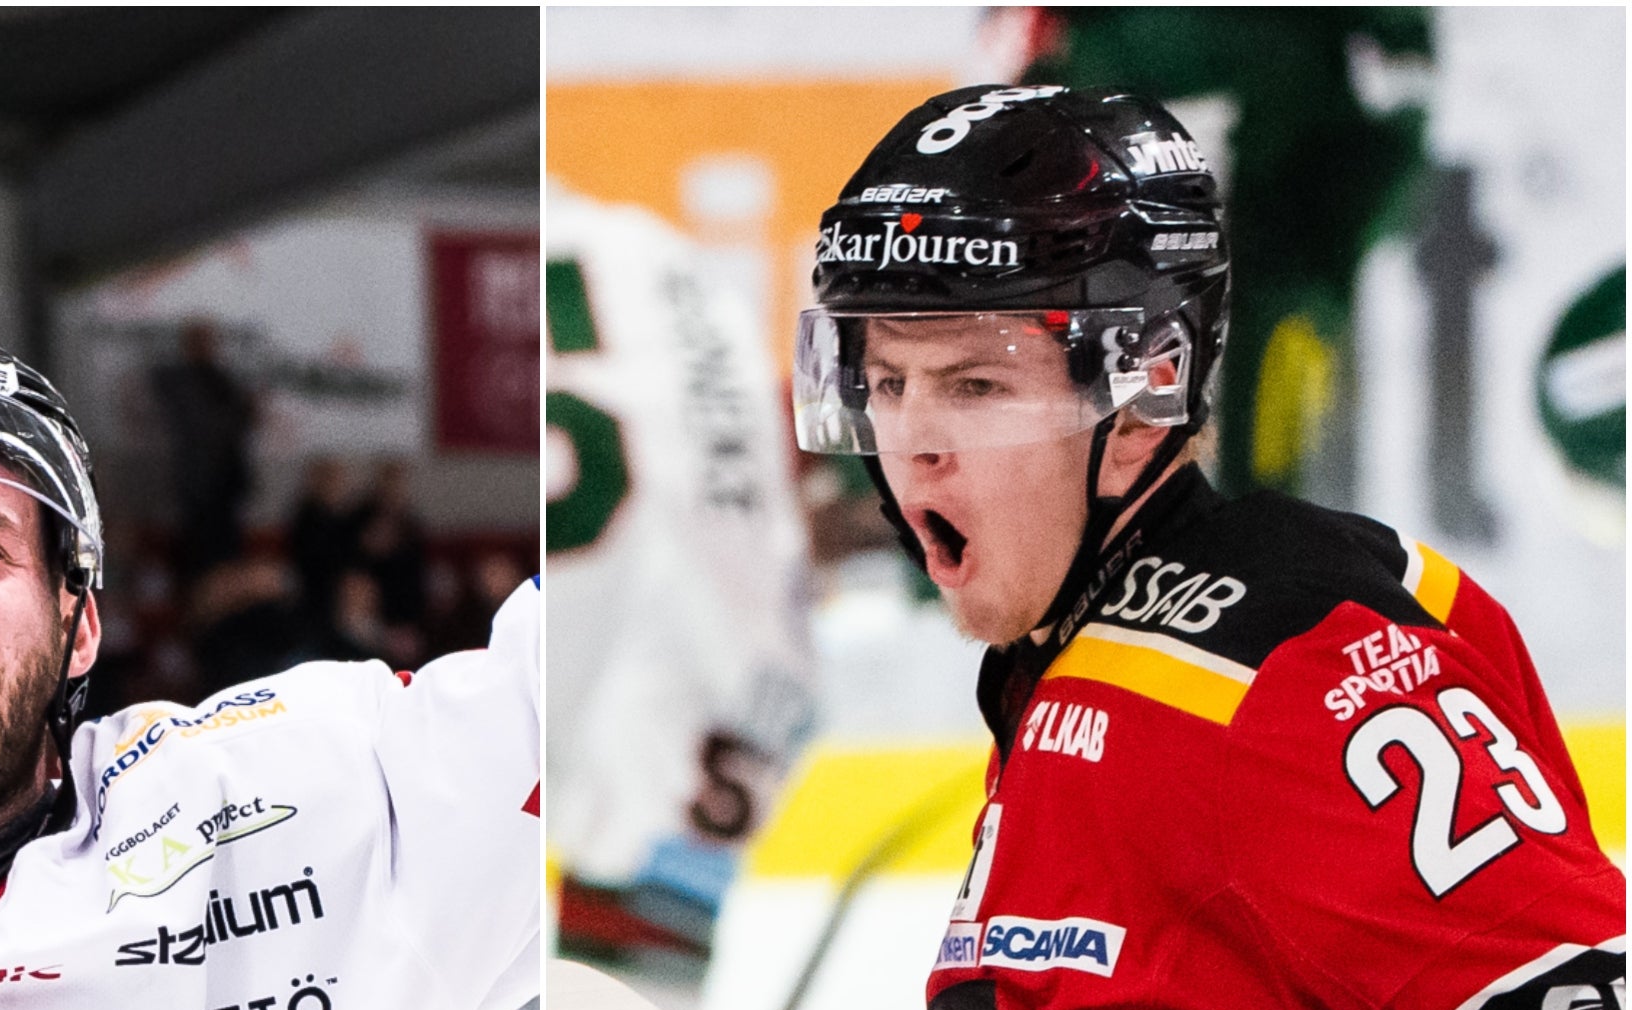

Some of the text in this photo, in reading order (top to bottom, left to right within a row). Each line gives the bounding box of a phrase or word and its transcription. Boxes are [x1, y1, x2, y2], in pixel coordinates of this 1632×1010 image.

[860, 185, 945, 204] BAUER
[1150, 231, 1219, 251] BAUER
[1099, 556, 1248, 634] SSAB
[1036, 701, 1110, 763] LKAB
[1344, 685, 1568, 900] 23
[104, 802, 182, 861] GGBOLAGET
[982, 924, 1109, 966] SCANIA
